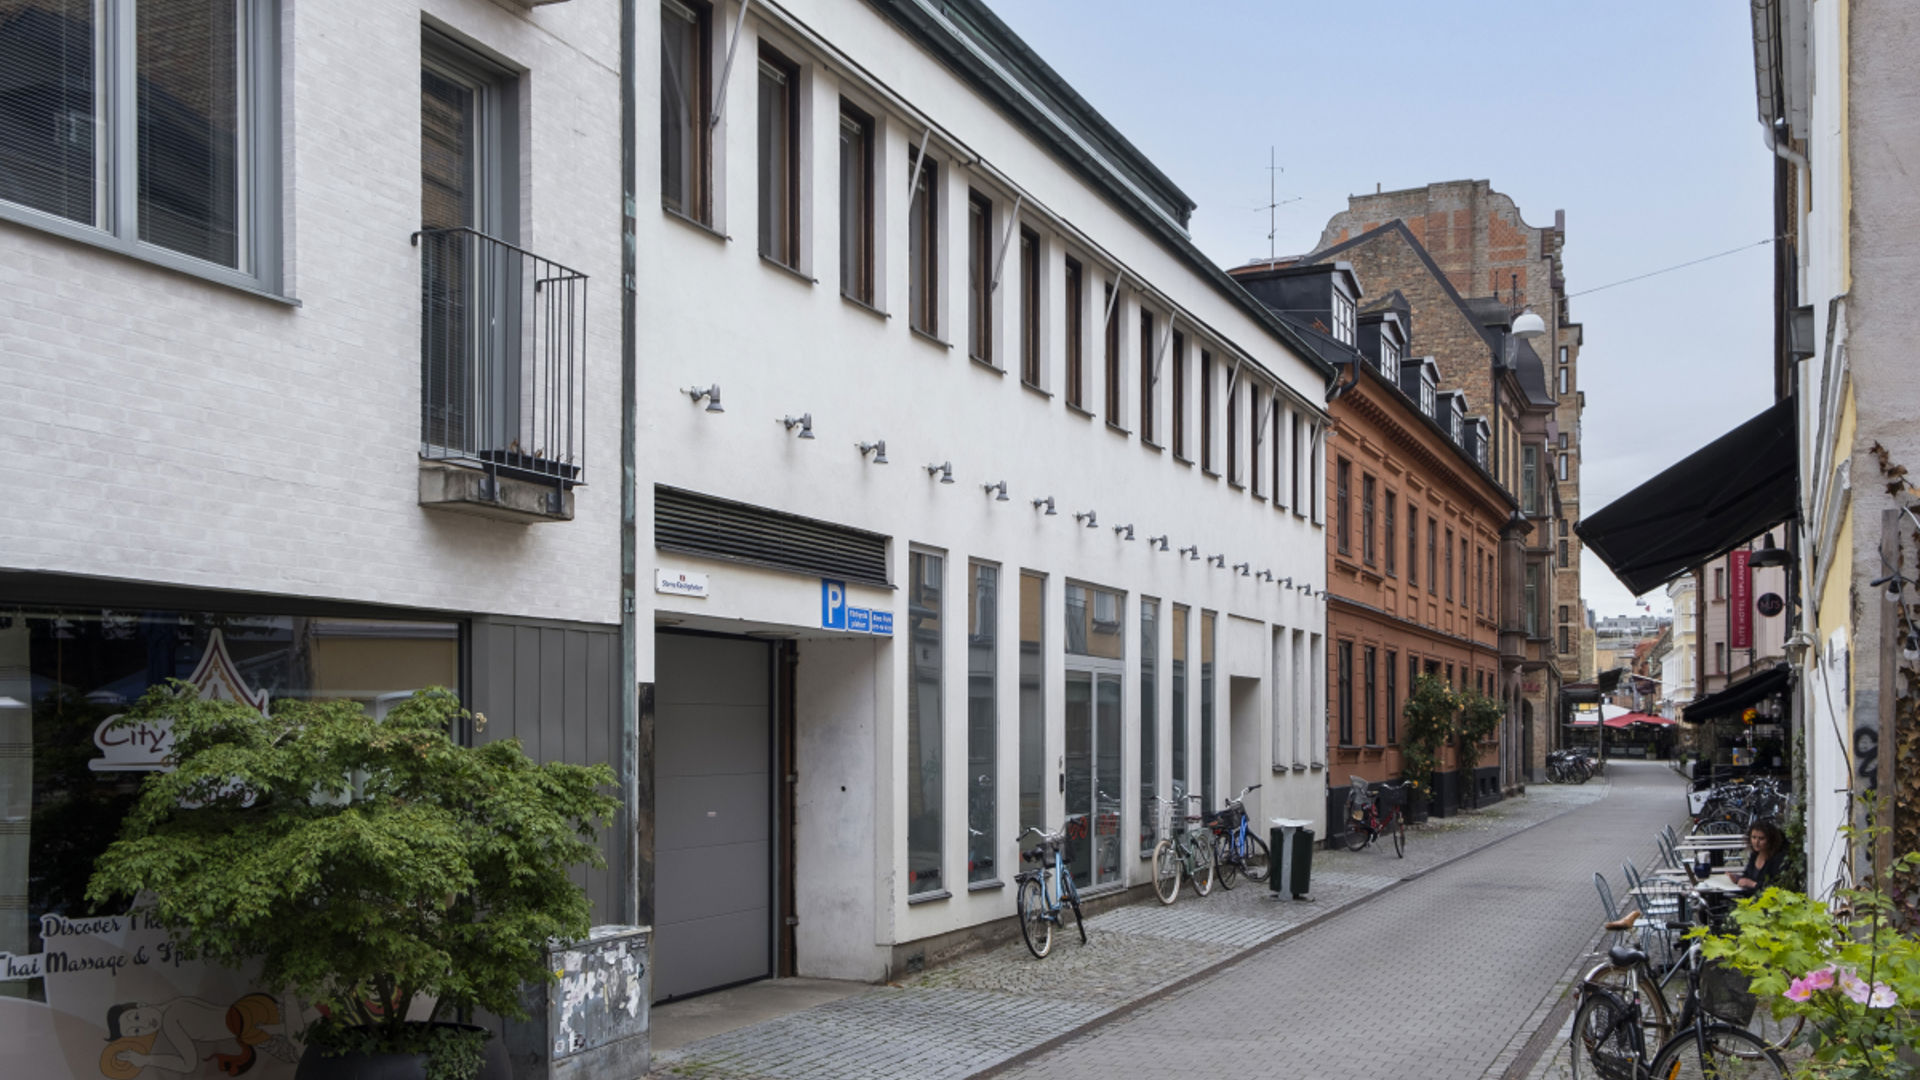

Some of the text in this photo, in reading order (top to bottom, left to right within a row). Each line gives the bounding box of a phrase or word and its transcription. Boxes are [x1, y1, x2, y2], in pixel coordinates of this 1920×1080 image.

[828, 583, 842, 624] P
[100, 718, 166, 753] City
[43, 915, 121, 937] Discover
[0, 953, 40, 977] hai
[45, 951, 127, 977] Massage
